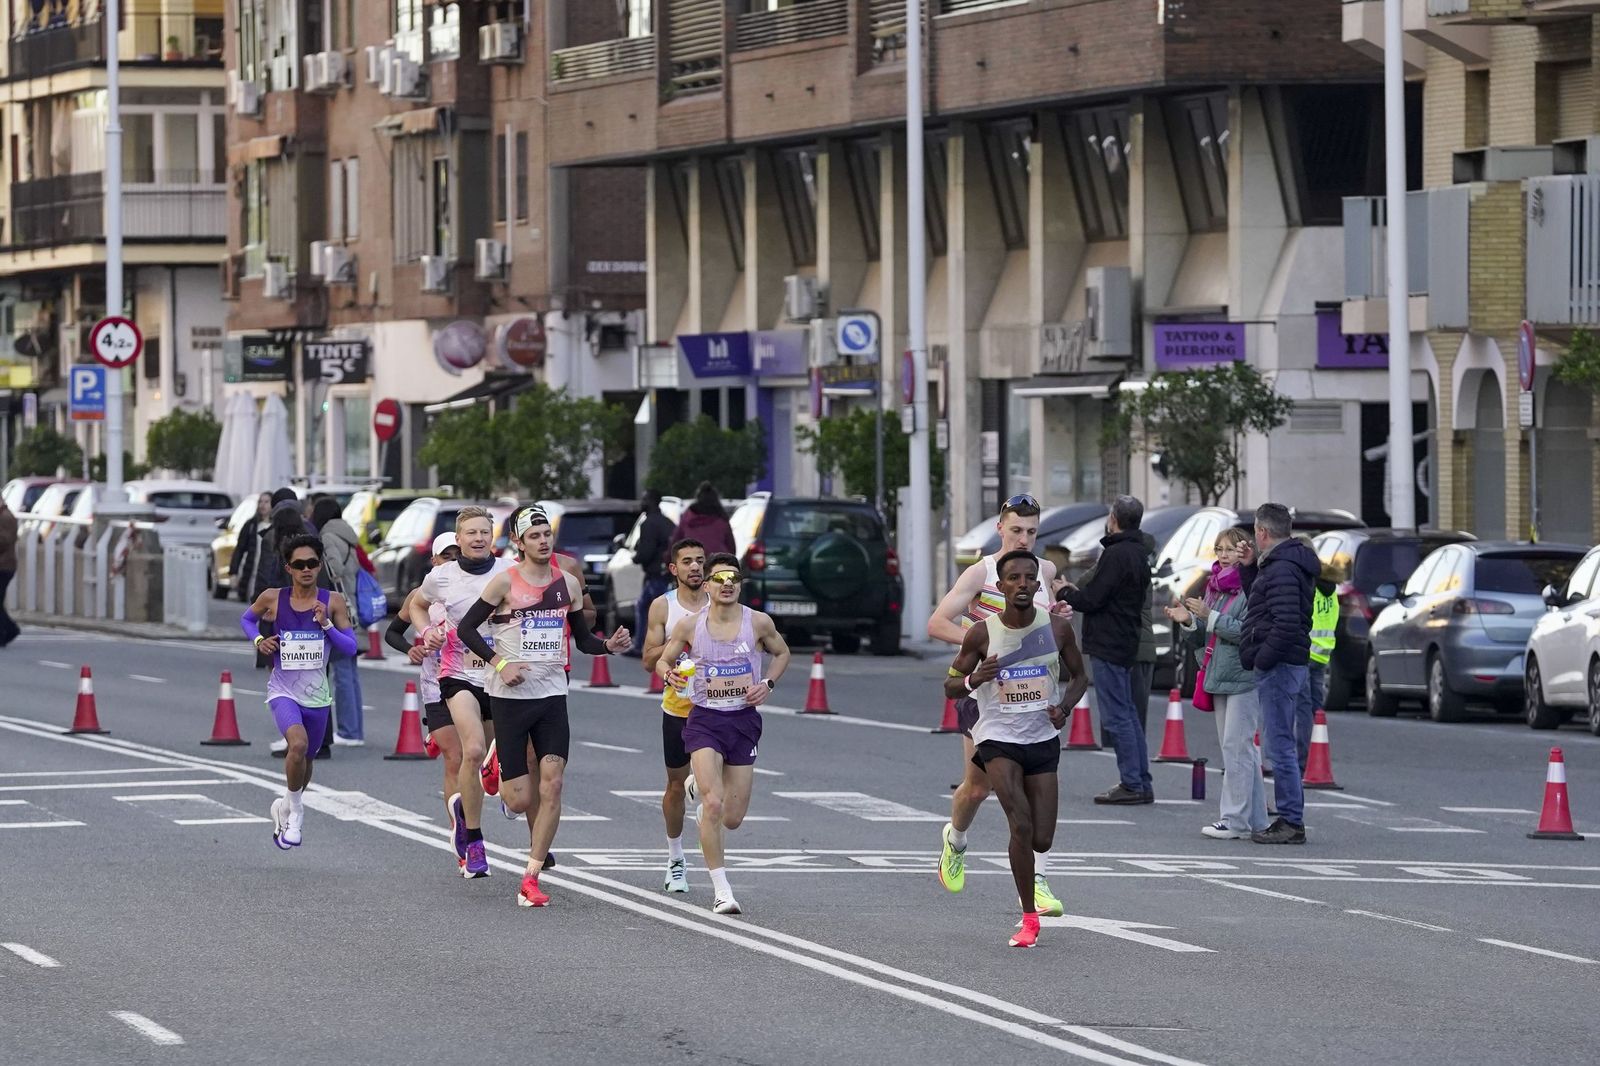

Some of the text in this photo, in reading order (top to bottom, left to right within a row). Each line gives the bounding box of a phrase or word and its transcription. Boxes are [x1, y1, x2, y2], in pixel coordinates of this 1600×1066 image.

[1164, 331, 1235, 342] TATTOO &
[305, 344, 362, 359] TINTE
[1164, 345, 1236, 356] PIERCING
[74, 370, 98, 401] P
[525, 609, 568, 619] SYNERGY
[281, 652, 323, 661] SYIANTURI
[720, 667, 747, 675] ZURICH
[1013, 668, 1041, 677] ZURICH
[707, 686, 750, 698] BOUKEBA
[1005, 690, 1042, 702] TEDROS
